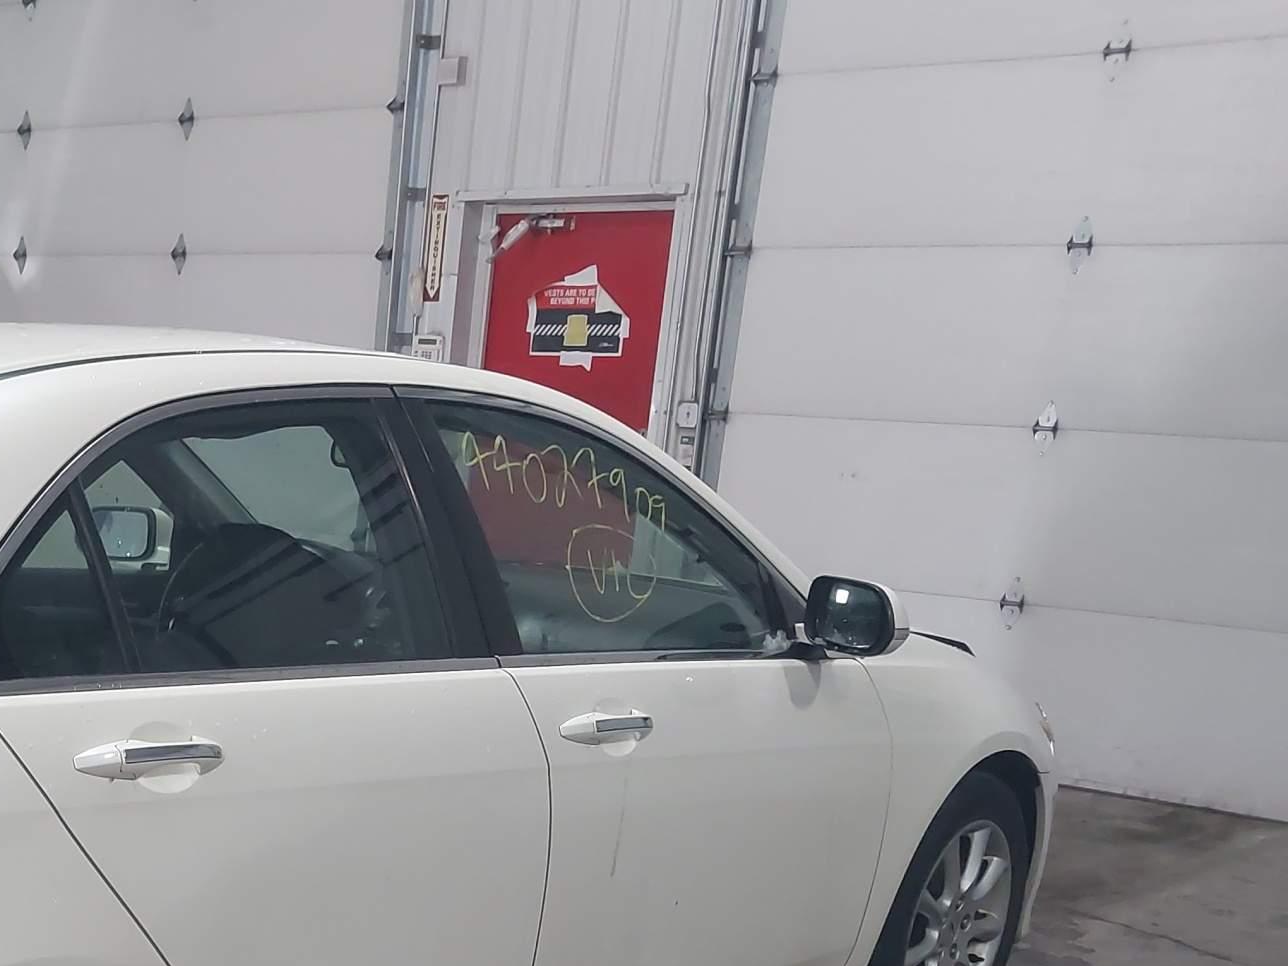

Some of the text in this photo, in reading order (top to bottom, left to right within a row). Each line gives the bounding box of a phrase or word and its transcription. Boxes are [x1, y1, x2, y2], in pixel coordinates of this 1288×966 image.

[544, 288, 565, 297] VESTS
[565, 288, 578, 297] ARE
[579, 288, 587, 297] TO
[576, 297, 589, 305] THIS
